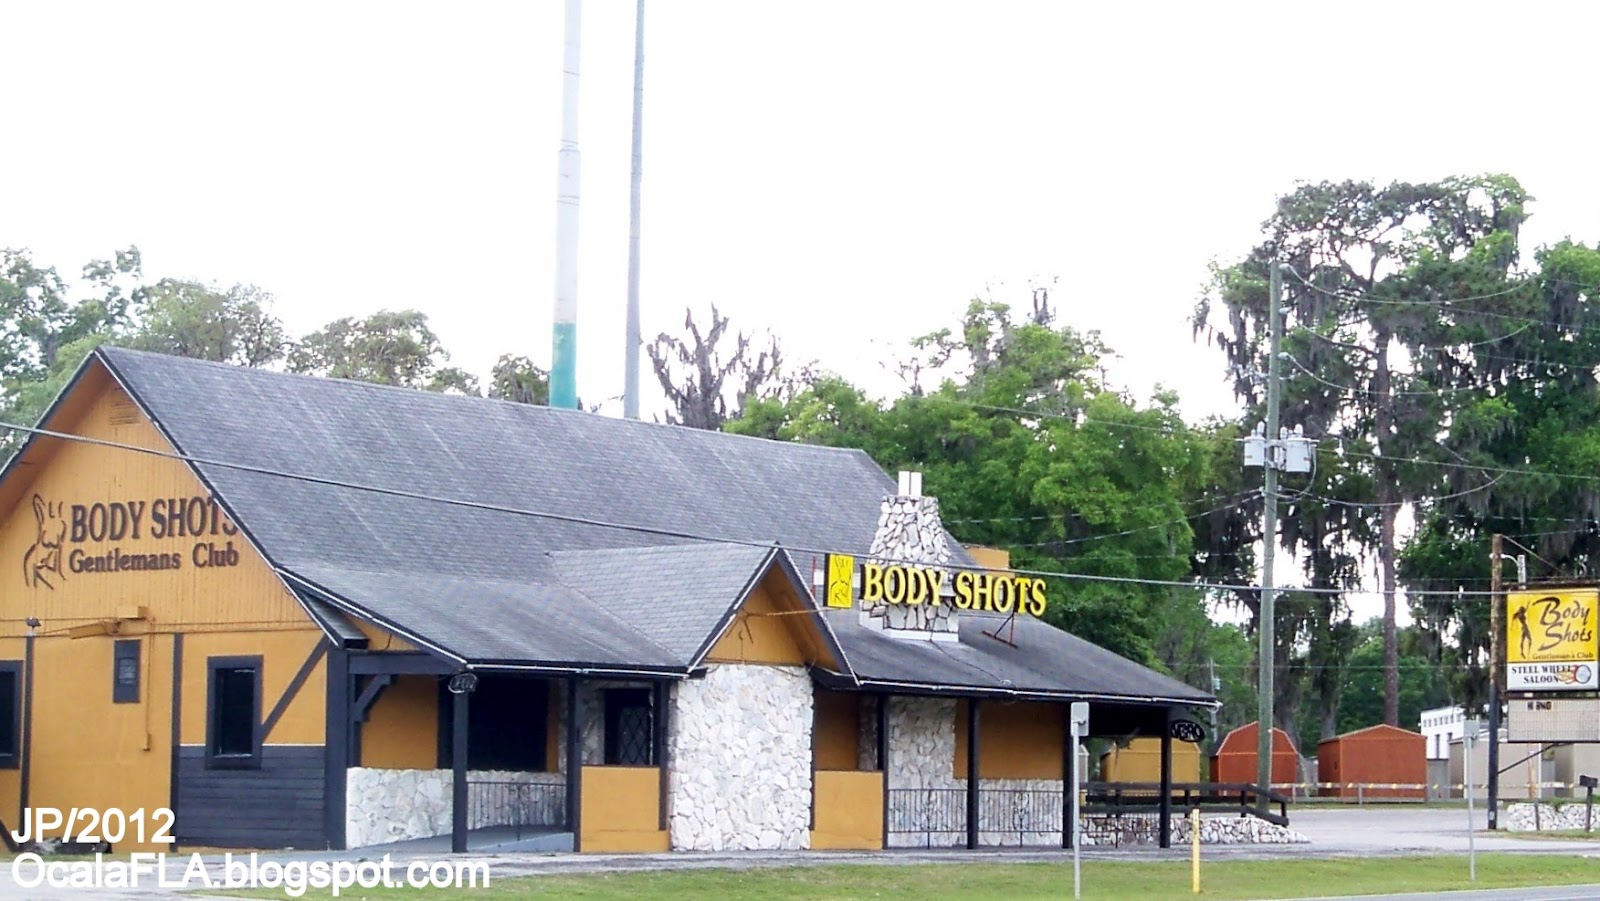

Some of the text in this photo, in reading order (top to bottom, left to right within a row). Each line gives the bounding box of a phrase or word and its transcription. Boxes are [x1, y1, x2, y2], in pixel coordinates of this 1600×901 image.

[70, 500, 145, 543] BODY
[69, 541, 239, 574] Gentlemans Club
[862, 563, 1047, 617] BODY SHOTS
[1532, 596, 1590, 626] Body
[1538, 621, 1592, 651] Shots
[1511, 665, 1540, 674] STEEL
[1576, 651, 1594, 659] Club
[1523, 675, 1559, 684] SALOON
